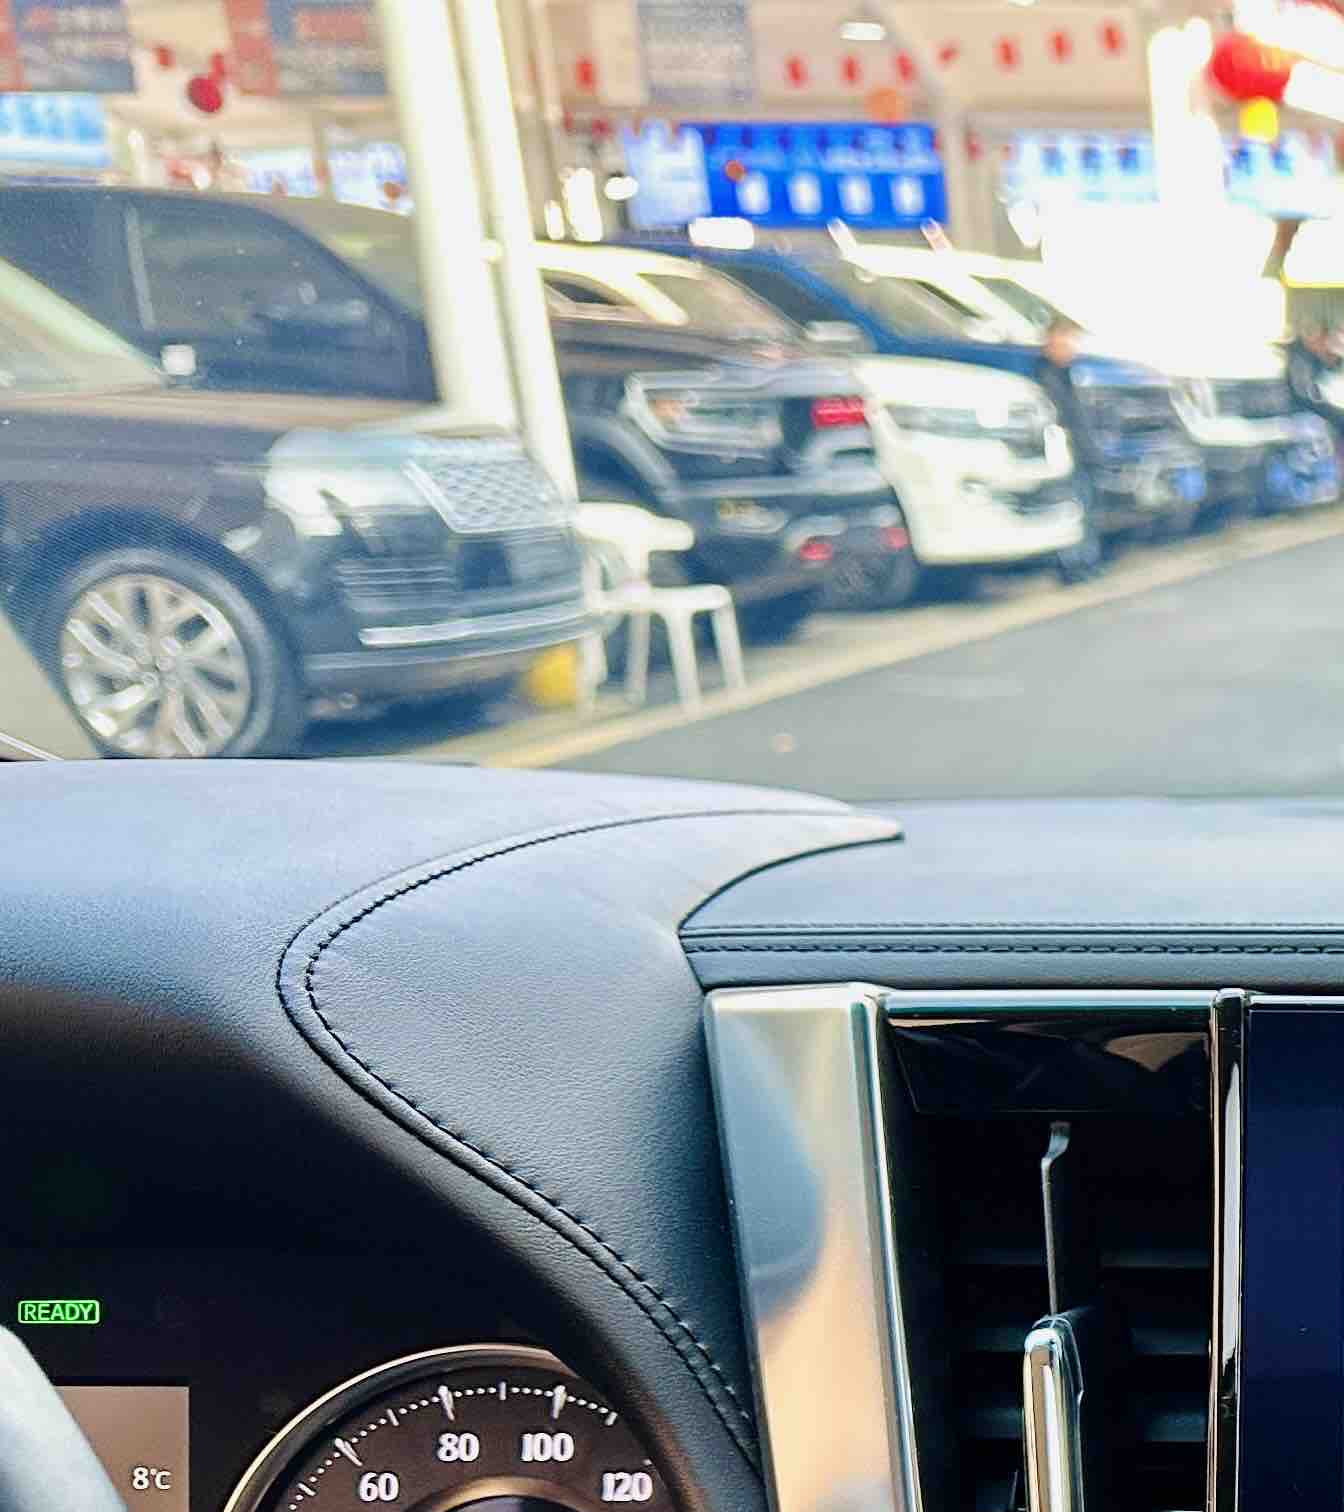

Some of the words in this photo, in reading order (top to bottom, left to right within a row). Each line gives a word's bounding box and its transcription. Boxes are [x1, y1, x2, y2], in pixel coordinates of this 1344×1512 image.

[24, 1303, 94, 1321] READY
[438, 1433, 479, 1461] 80
[521, 1433, 574, 1461] 100
[360, 1473, 398, 1501] 60
[603, 1472, 652, 1501] 120
